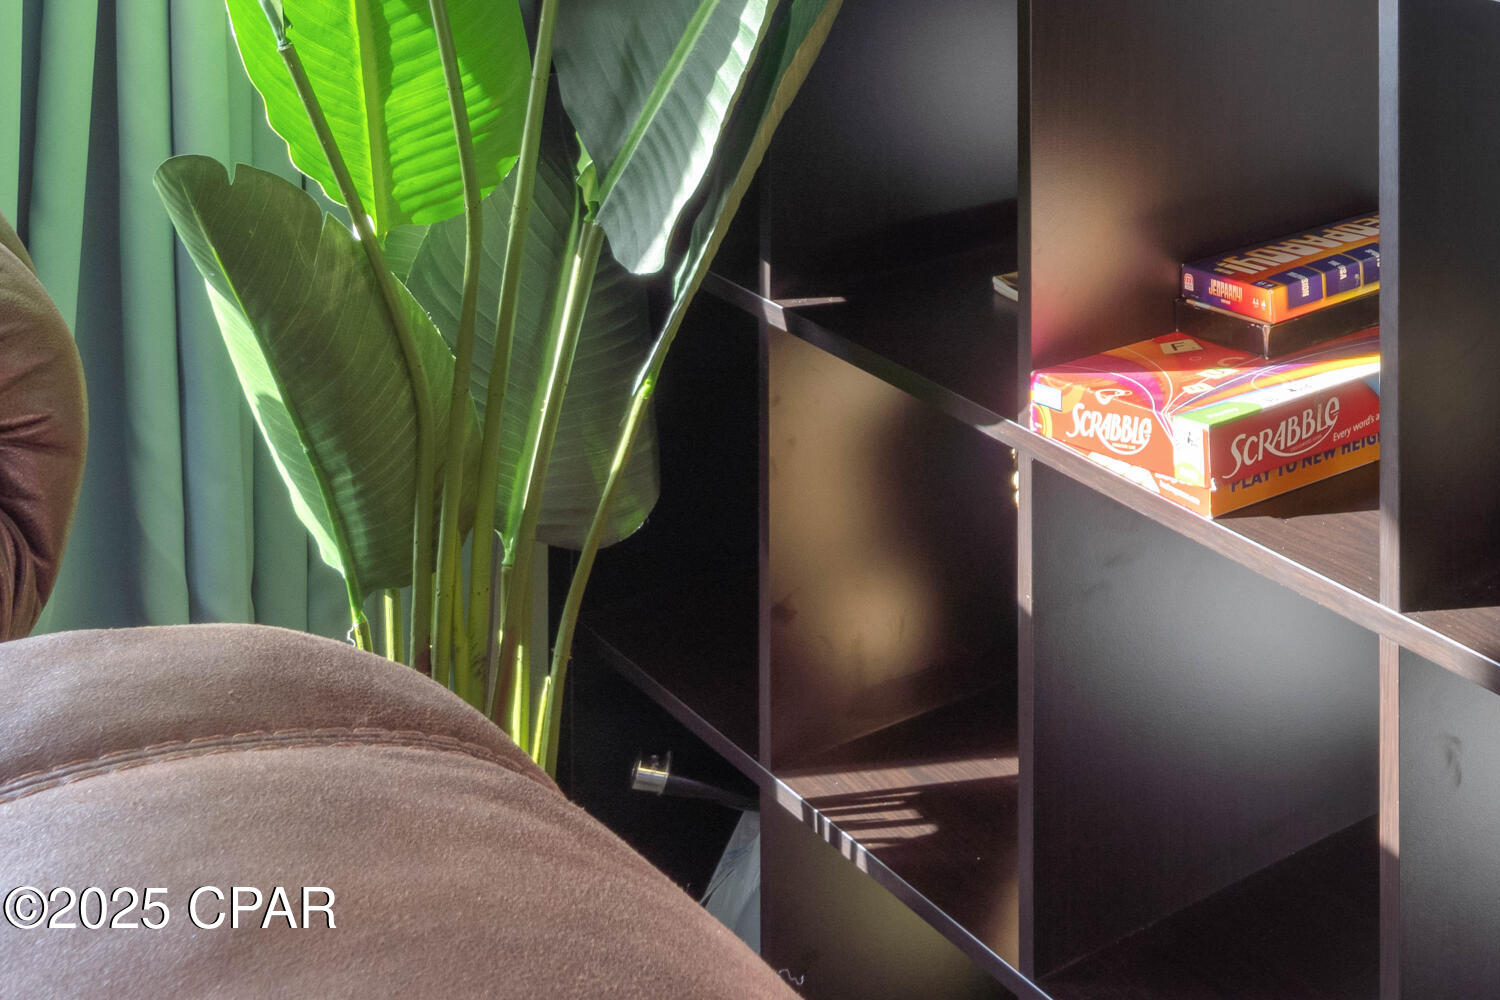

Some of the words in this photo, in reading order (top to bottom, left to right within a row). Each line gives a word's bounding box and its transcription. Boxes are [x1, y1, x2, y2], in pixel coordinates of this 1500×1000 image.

[1066, 402, 1152, 450] SCRABBLE
[1222, 397, 1340, 478] SCRABBLE
[1333, 427, 1351, 442] Every
[1353, 415, 1375, 431] word's
